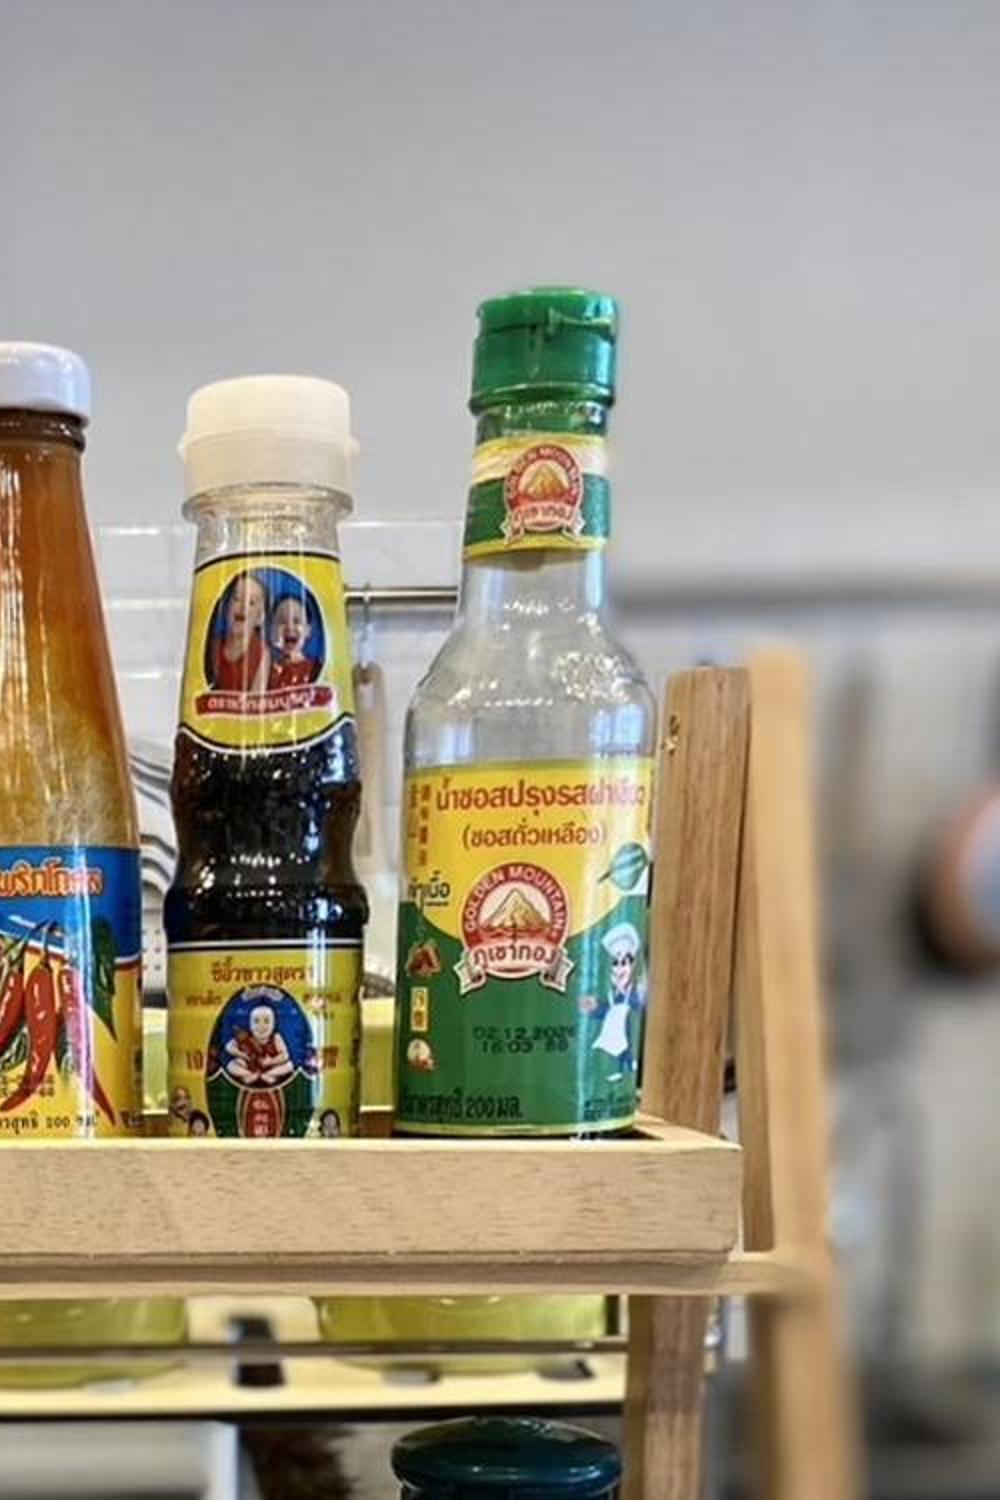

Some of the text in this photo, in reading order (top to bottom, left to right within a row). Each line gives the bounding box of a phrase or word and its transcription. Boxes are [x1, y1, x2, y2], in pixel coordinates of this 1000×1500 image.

[464, 868, 506, 932] GOLDEN
[508, 865, 567, 931] MOUNTAIN
[473, 943, 557, 970] ภูเขาทอง
